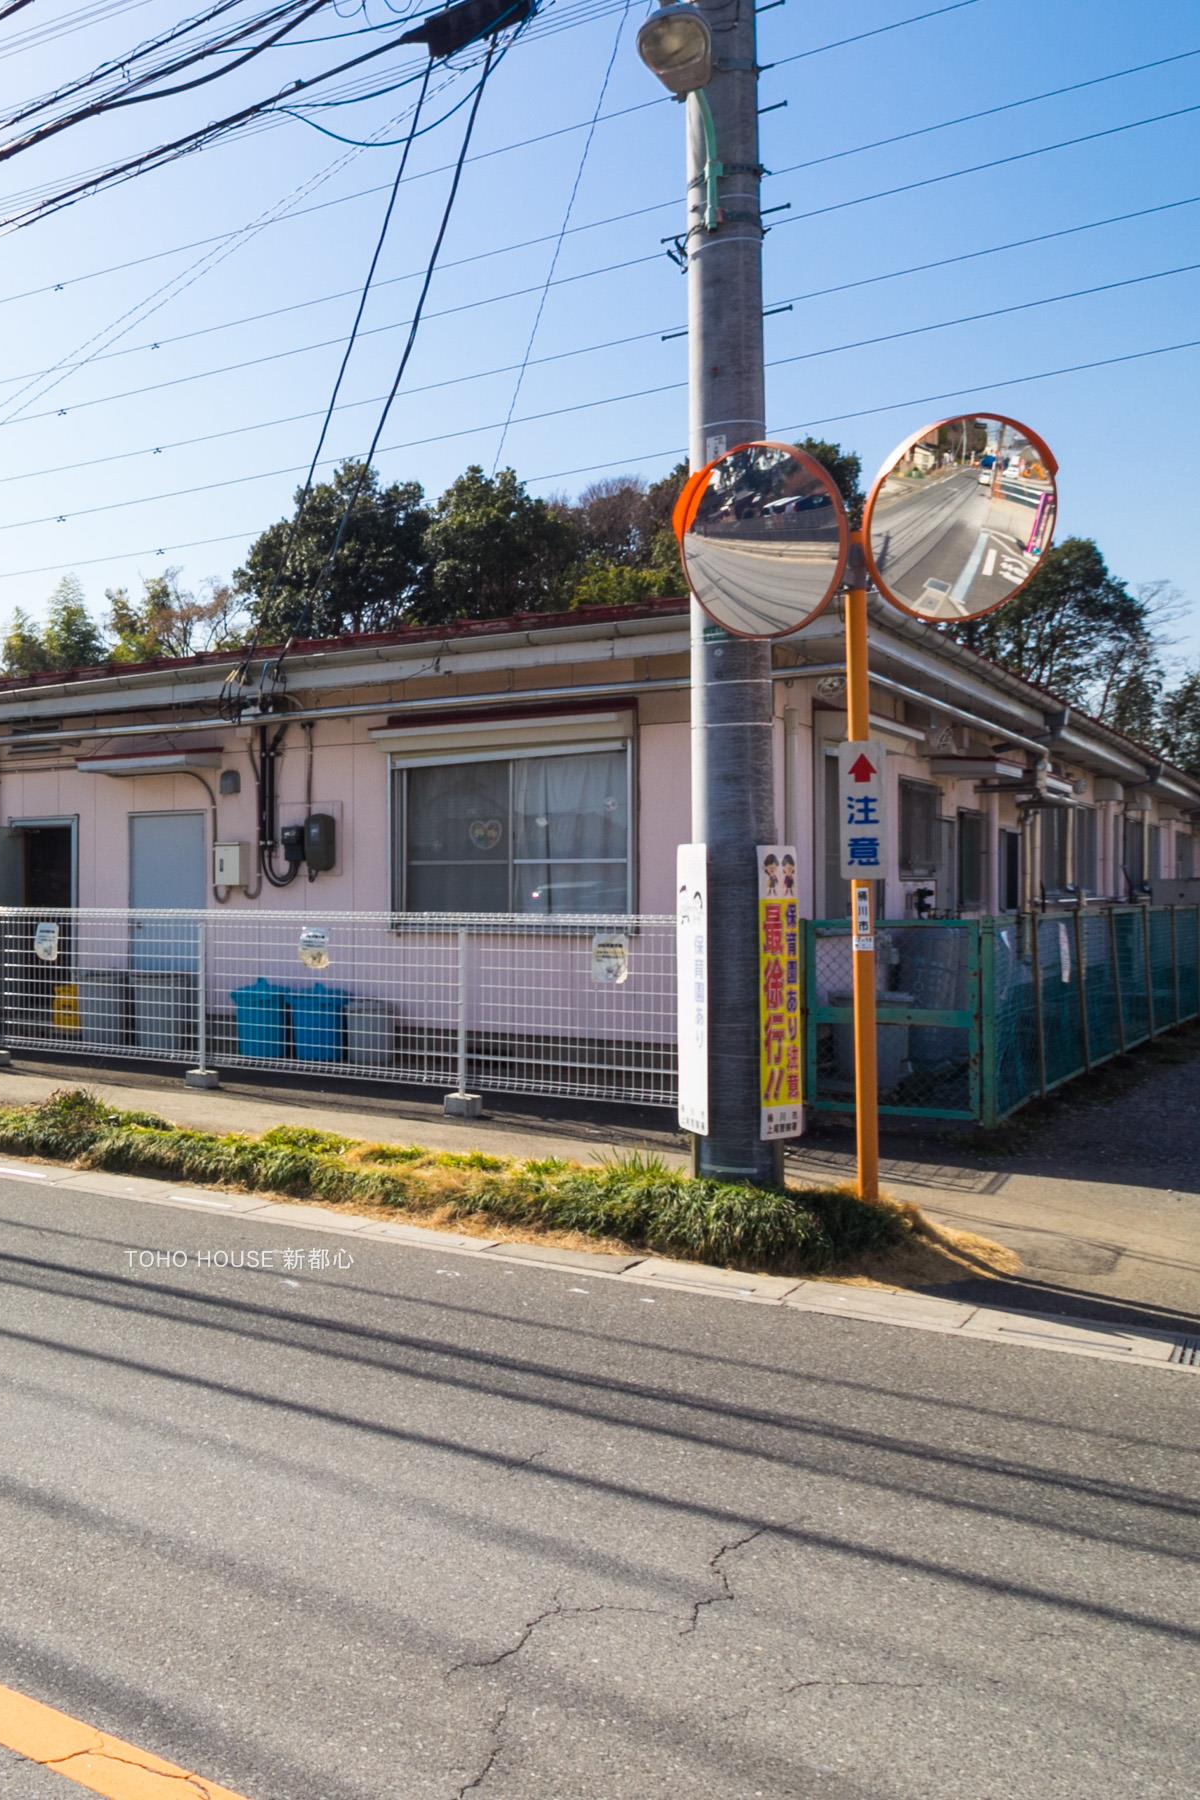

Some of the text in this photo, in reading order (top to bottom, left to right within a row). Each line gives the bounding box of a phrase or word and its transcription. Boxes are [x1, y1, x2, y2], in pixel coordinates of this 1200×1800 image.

[847, 796, 880, 866] 注意
[786, 903, 799, 1098] 保育園あり注意
